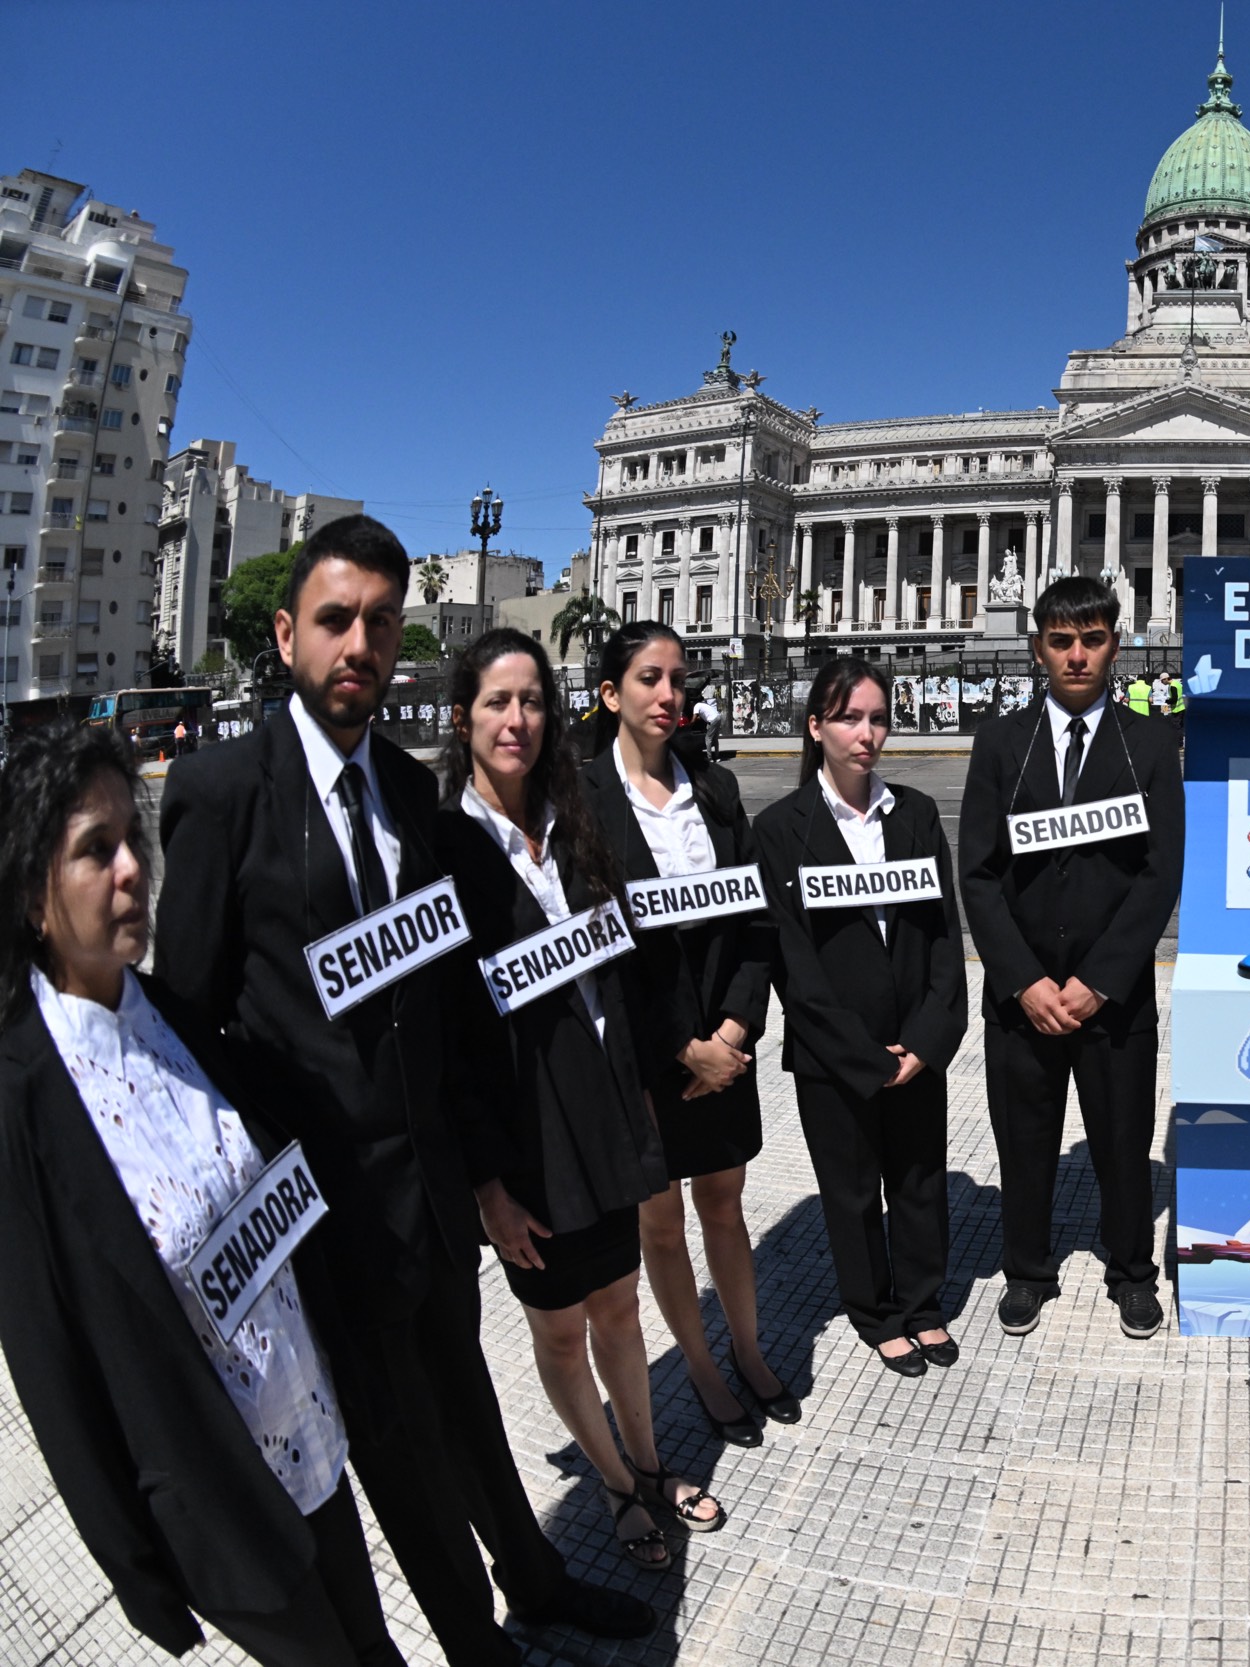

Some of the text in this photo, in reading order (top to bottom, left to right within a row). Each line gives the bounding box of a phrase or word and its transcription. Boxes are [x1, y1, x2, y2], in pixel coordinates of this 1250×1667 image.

[1014, 802, 1143, 845] SENADOR
[631, 875, 762, 919] SENADORA
[806, 867, 936, 899] SENADORA
[318, 892, 462, 999] SENADOR
[491, 912, 627, 1001] SENADORA
[200, 1163, 318, 1320] SENADORA
